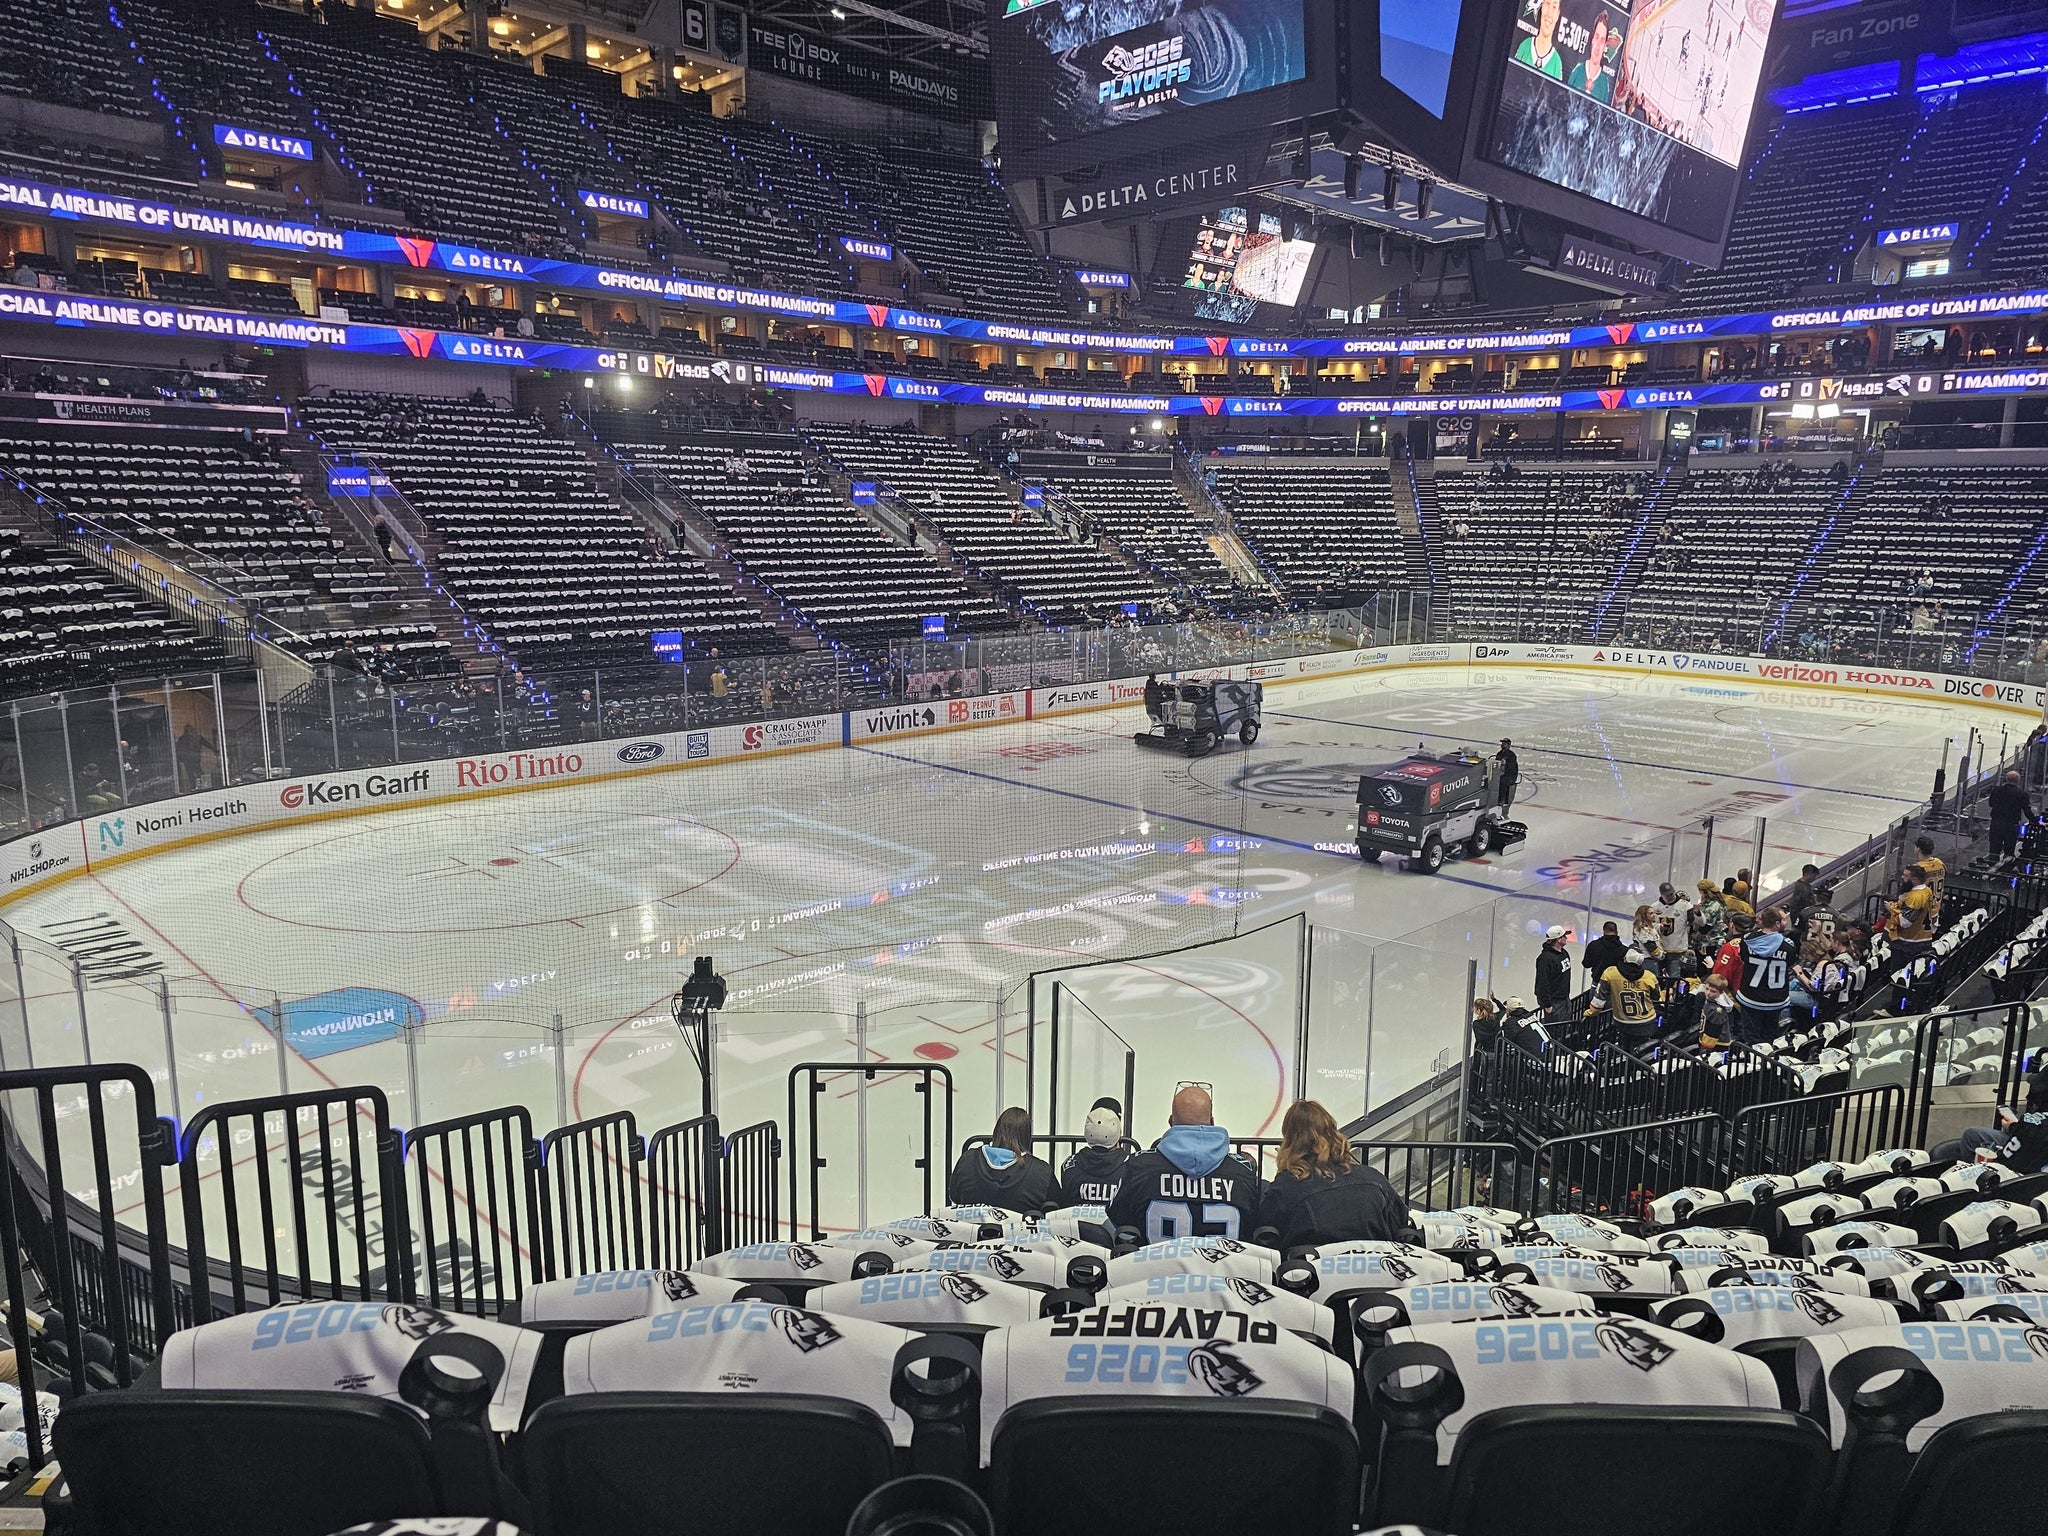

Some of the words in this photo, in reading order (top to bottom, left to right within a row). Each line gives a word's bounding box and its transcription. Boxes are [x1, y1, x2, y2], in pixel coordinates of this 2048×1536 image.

[686, 8, 704, 40] 6
[1557, 16, 1582, 53] 5:30
[1811, 24, 1853, 48] Fan
[1860, 13, 1920, 40] Zone
[752, 28, 785, 50] TEE
[808, 44, 840, 66] BOX
[1132, 36, 1184, 70] 2026
[773, 55, 821, 80] LOUNGE
[889, 70, 958, 101] PAUDAVIS
[1099, 58, 1191, 103] PLAYOFFS
[1147, 89, 1178, 105] DELTA
[244, 132, 305, 156] DELTA
[1082, 183, 1147, 213] DELTA
[1155, 164, 1237, 197] CENTER
[0, 182, 49, 209] CIAL
[50, 192, 137, 222] AIRLINE
[139, 206, 170, 226] OF
[172, 211, 228, 236] UTAH
[232, 220, 344, 250] MAMMOTH
[598, 196, 643, 215] DELTA
[1900, 226, 1951, 242] DELTA
[855, 243, 887, 257] DELTA
[469, 254, 524, 273] DELTA
[1576, 249, 1614, 276] DELTA
[1617, 261, 1657, 286] CENTER
[1091, 273, 1125, 285] DELTA
[598, 271, 664, 294] OFFICIAL
[664, 281, 716, 302] AIRLINE
[716, 288, 735, 303] OF
[736, 290, 769, 308] UTAH
[770, 294, 835, 316] MAMMOTH
[0, 294, 53, 317] CIAL
[55, 300, 141, 327] AIRLINE
[143, 310, 174, 328] OF
[177, 313, 233, 335] UTAH
[236, 320, 346, 345] MAMMOTH
[909, 316, 942, 329] DELTA
[1771, 311, 1840, 328] OFFICIAL
[1841, 305, 1904, 323] AIRLINE
[1905, 302, 1930, 317] OF
[1931, 298, 1977, 315] UTAH
[987, 325, 1032, 341] OFFICIAL
[1031, 331, 1070, 345] AIRLINE
[1071, 334, 1086, 346] OF
[1087, 336, 1114, 348] UTAH
[1115, 338, 1174, 351] MAMMOTH
[1659, 323, 1704, 336] DELTA
[470, 342, 524, 360] DELTA
[1250, 343, 1288, 352] DELTA
[1344, 340, 1398, 354] OFFICIAL
[1398, 338, 1446, 352] AIRLINE
[1447, 337, 1466, 350] OF
[1466, 335, 1499, 349] UTAH
[1501, 332, 1570, 348] MAMMOTH
[637, 356, 649, 373] 0
[676, 363, 710, 379] 49:05
[735, 366, 746, 382] 0
[769, 369, 833, 388] MAMMOTH
[908, 382, 940, 396] DELTA
[1649, 390, 1693, 402] DELTA
[1800, 382, 1812, 397] 0
[1843, 382, 1884, 396] 49:05
[1917, 376, 1932, 392] 0
[76, 404, 116, 416] HEALTH
[118, 407, 151, 417] PLANS
[984, 390, 1029, 405] OFFICIAL
[1028, 395, 1067, 408] AIRLINE
[1067, 397, 1082, 409] OF
[1082, 398, 1110, 410] UTAH
[1110, 399, 1169, 411] MAMMOTH
[1245, 402, 1282, 411] DELTA
[1337, 400, 1391, 413] OFFICIAL
[1391, 399, 1439, 412] AIRLINE
[1439, 398, 1457, 411] OF
[1458, 397, 1491, 410] UTAH
[1492, 396, 1561, 409] MAMMOTH
[1436, 416, 1473, 432] G2G
[1612, 651, 1667, 666] DELTA
[1692, 658, 1750, 673] FANDUEL
[1249, 668, 1266, 677] SME
[1757, 663, 1838, 684] verizon
[1845, 670, 1936, 690] HONDA
[1057, 690, 1098, 704] FILEVINE
[1944, 678, 2024, 704] DISCOVER
[948, 700, 970, 724] PB
[972, 700, 996, 710] PEANUT
[972, 709, 996, 720] BETTER
[764, 722, 795, 734] CRAIG
[797, 718, 827, 731] SWAPP
[866, 709, 920, 734] vivint
[689, 734, 707, 745] BUILT
[778, 727, 822, 740] ASSOCIATES
[624, 744, 660, 761] Ford
[689, 748, 707, 758] TOUGH
[307, 780, 360, 805] Ken
[365, 768, 430, 797] Garff
[1383, 770, 1429, 782] TOYOTA
[1443, 775, 1470, 794] TOYOTA
[136, 810, 182, 835] Nomi
[188, 799, 248, 825] Health
[1380, 816, 1410, 829] TOYOTA
[1814, 912, 1834, 921] FLEURY
[1720, 954, 1730, 965] 5
[1749, 957, 1787, 990] 70
[1619, 990, 1649, 1017] 61
[1160, 1173, 1234, 1202] COOLEY
[728, 1243, 788, 1261] 2026
[929, 1250, 988, 1271] 2026
[1320, 1256, 1381, 1275] 2026
[1534, 1258, 1597, 1280] 2026
[572, 1269, 655, 1296] 2026
[860, 1273, 940, 1304] 2026
[1146, 1274, 1226, 1295] 2026
[1410, 1284, 1493, 1311] 2026
[1711, 1286, 1795, 1315] 2026
[251, 1302, 385, 1351] 2026
[647, 1302, 771, 1343] 2026
[1050, 1305, 1278, 1345] PLAYOFFS
[1475, 1322, 1601, 1365] 2026
[1902, 1325, 2034, 1363] 2026
[1064, 1343, 1191, 1384] 2026
